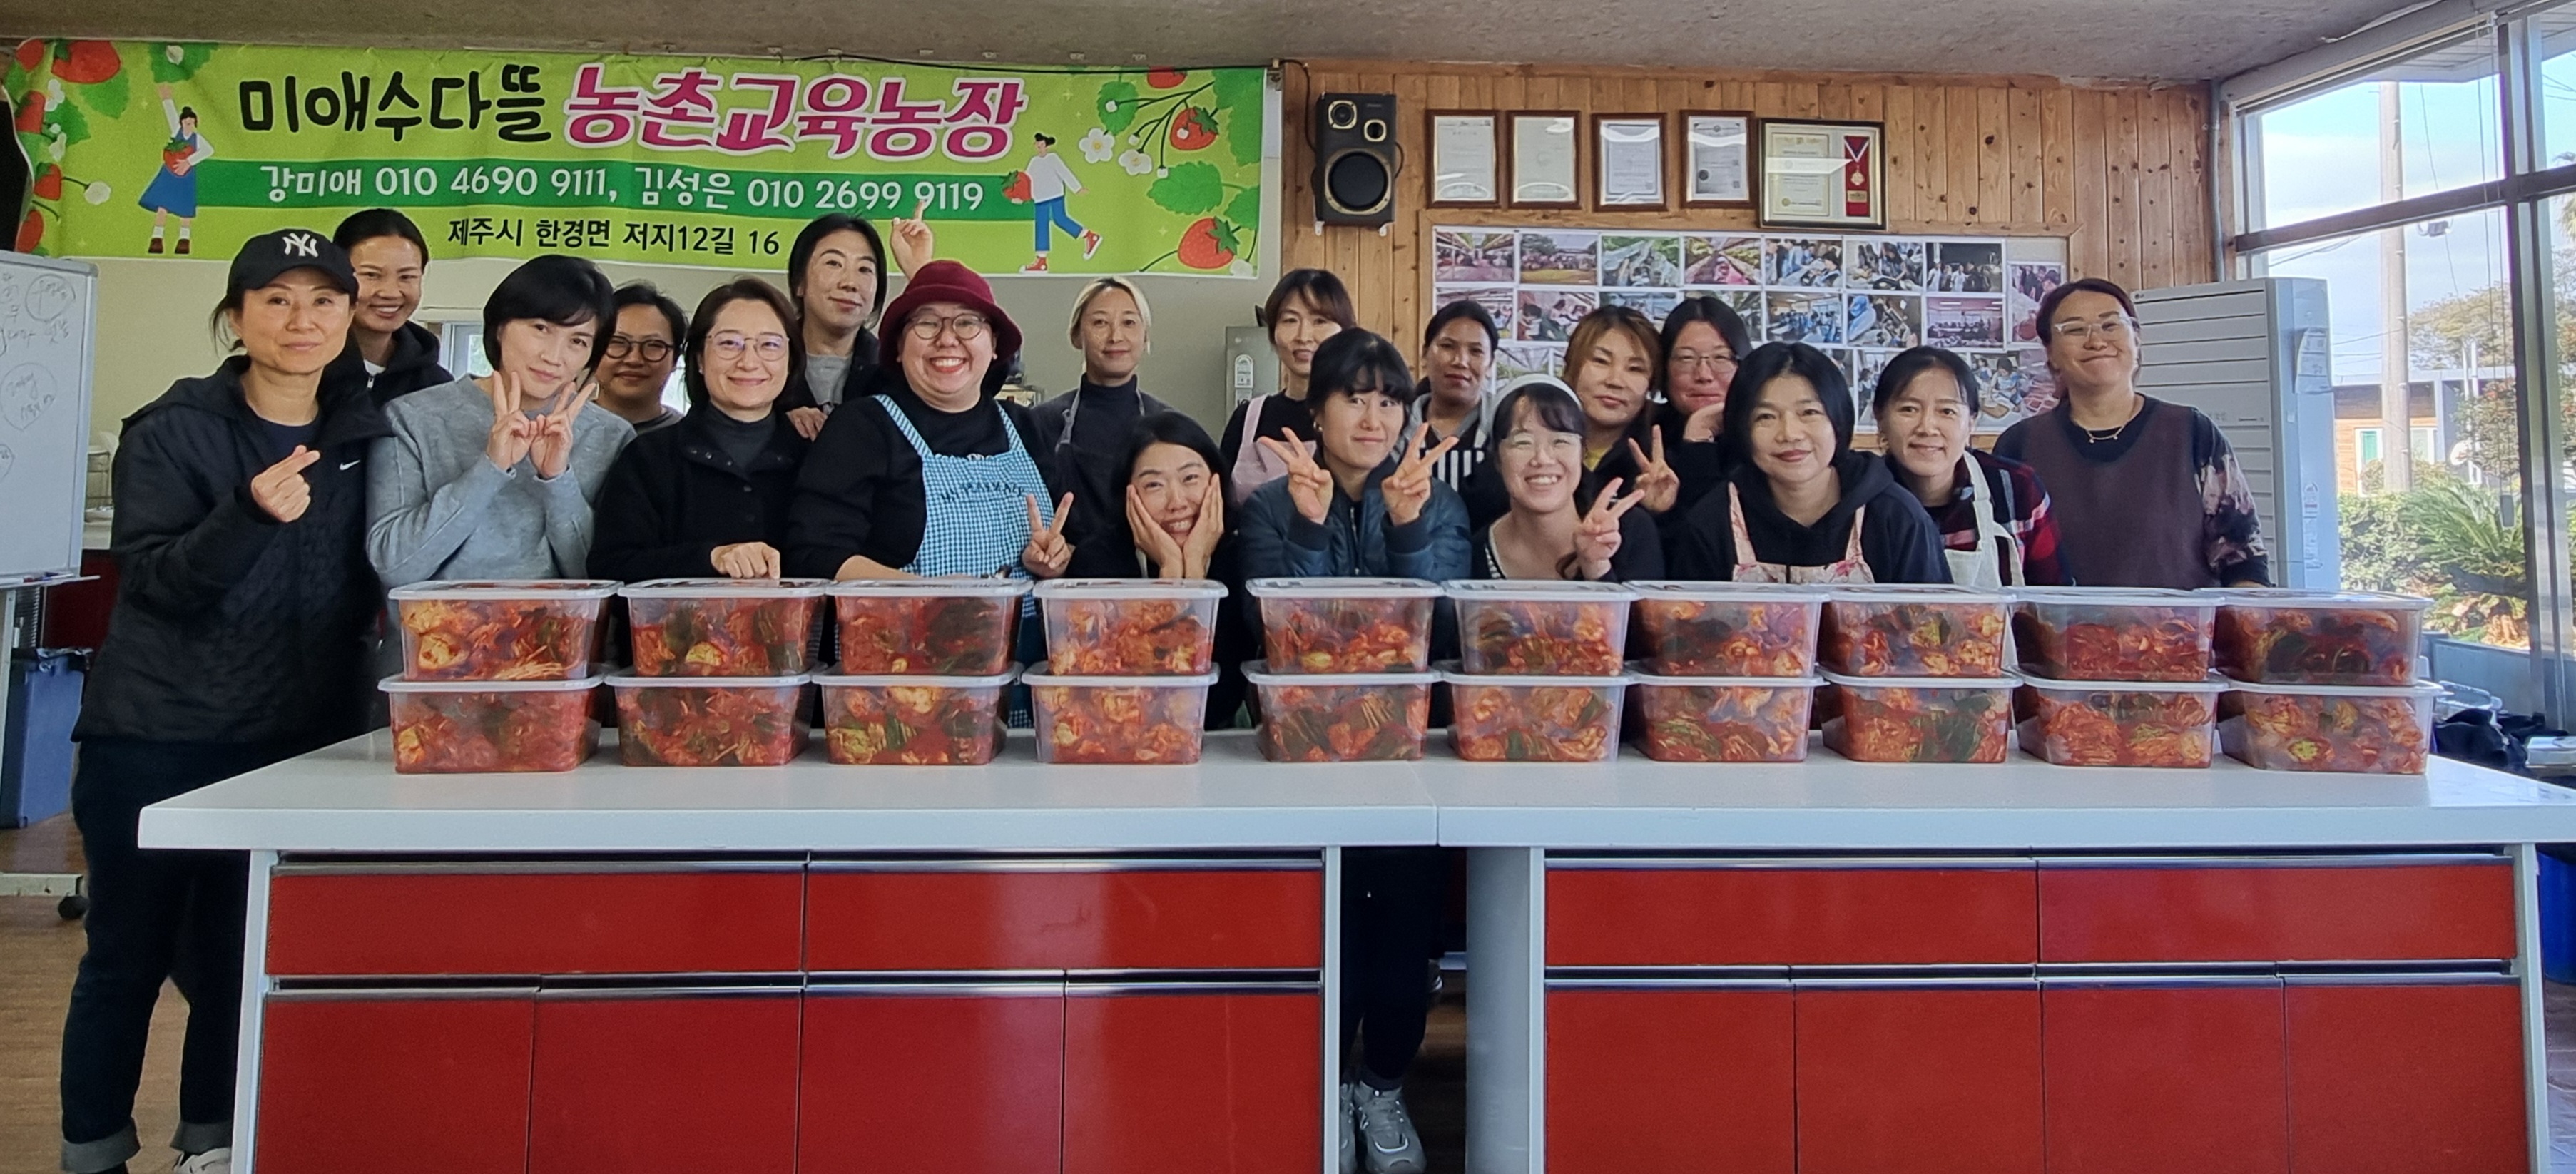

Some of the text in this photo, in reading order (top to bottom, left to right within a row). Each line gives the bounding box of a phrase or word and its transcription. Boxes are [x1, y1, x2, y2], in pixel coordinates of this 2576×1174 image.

[240, 63, 1028, 160] 미애수다뜰 농촌교육농장
[260, 165, 984, 210] 강미애 010 4690 9111, 김성은 010 2699 9119
[282, 233, 319, 257] NY
[448, 218, 780, 255] 제주시 한경면 저지12길 16
